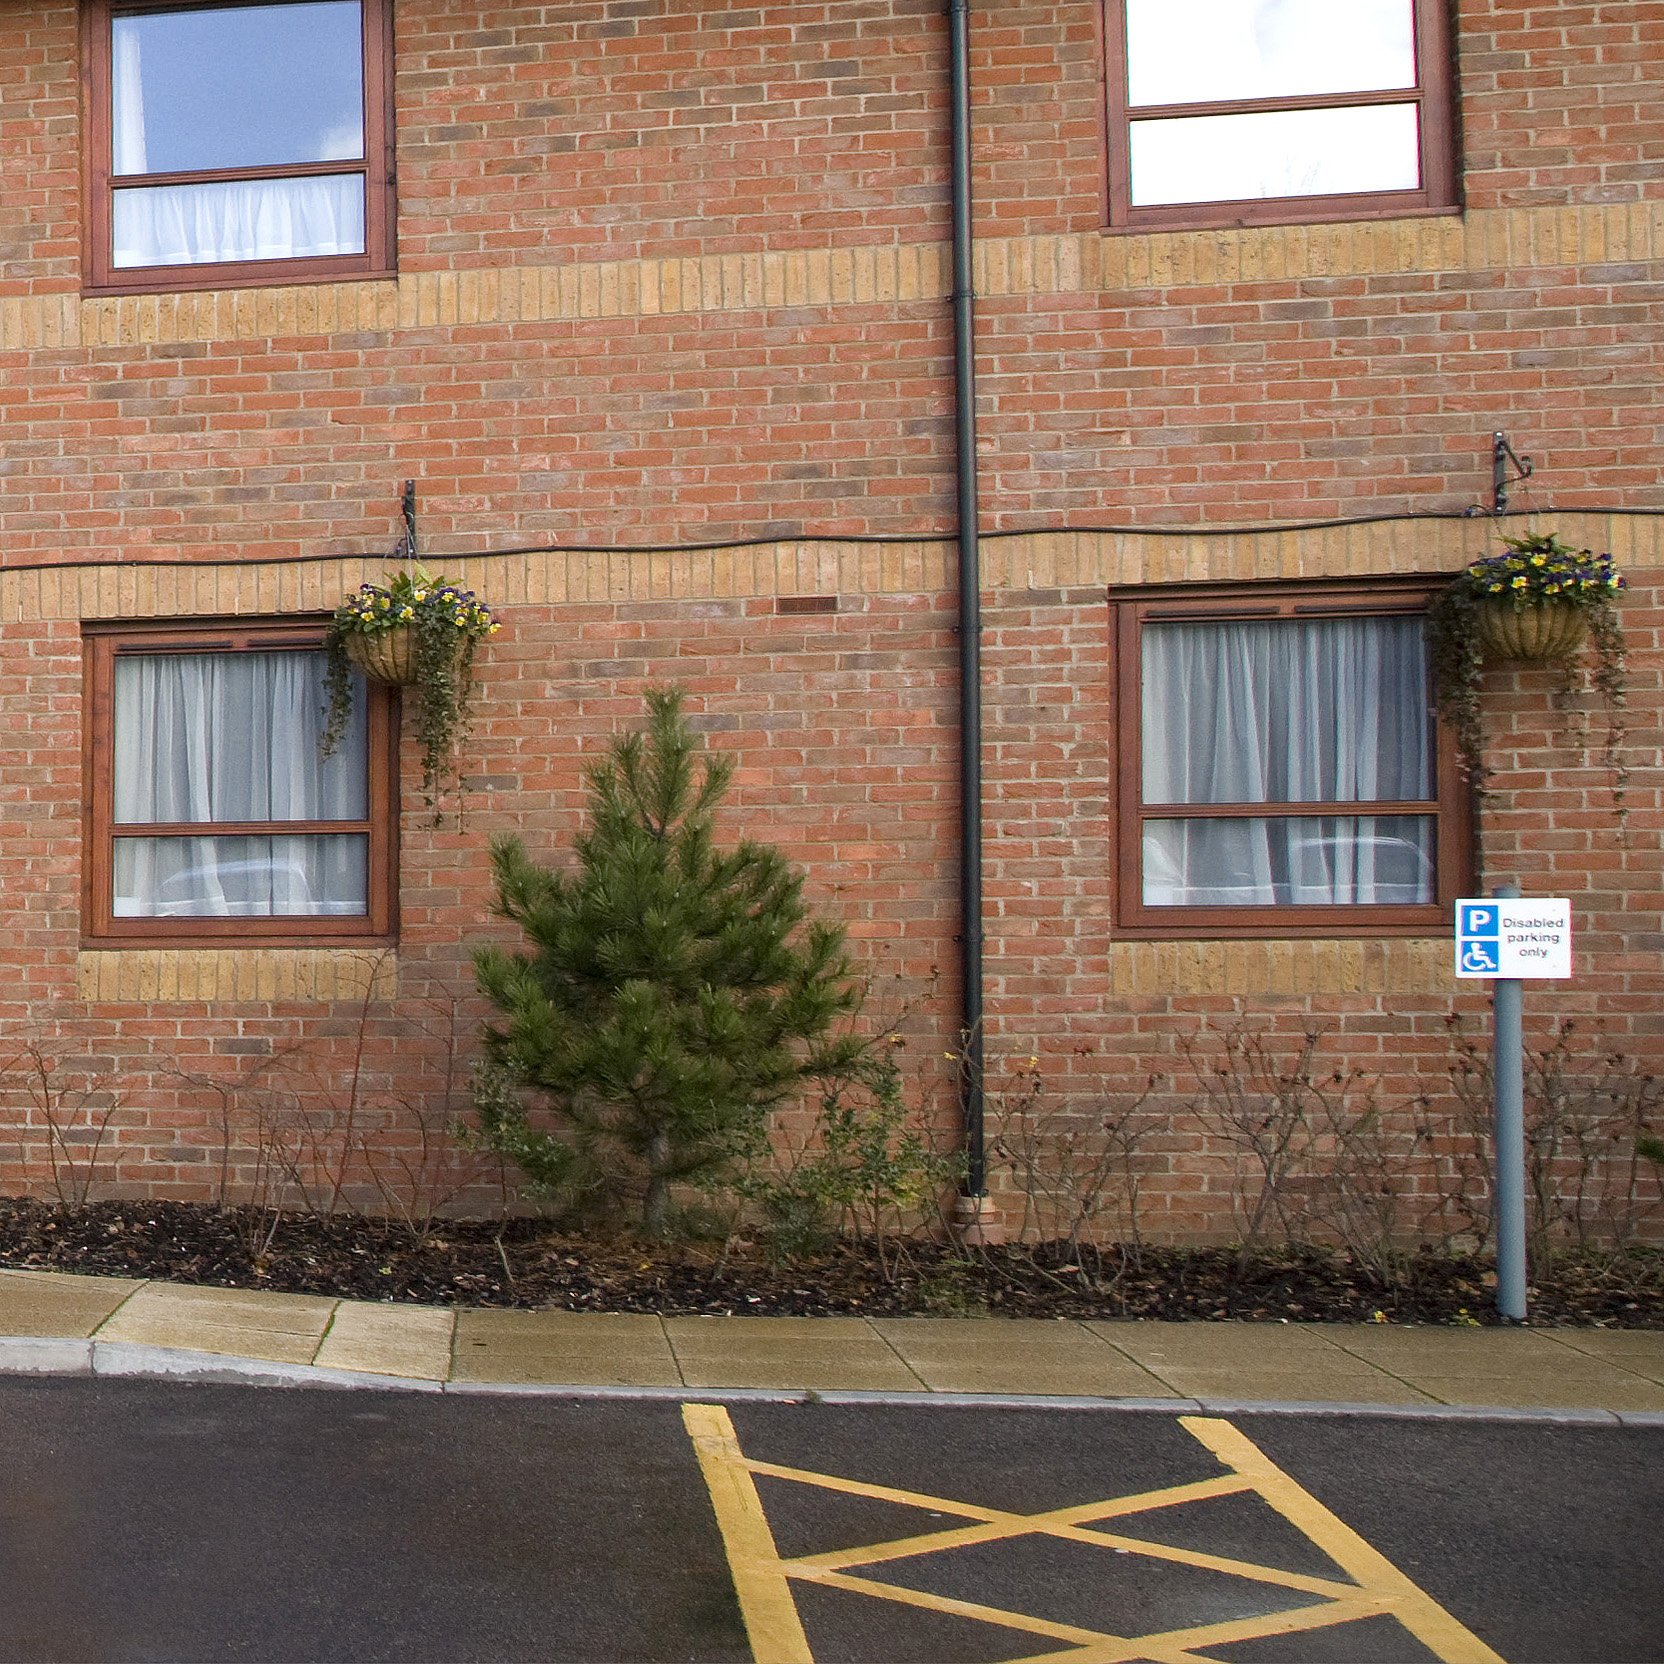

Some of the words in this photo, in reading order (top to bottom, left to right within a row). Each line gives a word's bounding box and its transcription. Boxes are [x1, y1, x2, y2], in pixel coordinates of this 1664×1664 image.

[1469, 909, 1492, 932] P
[1503, 918, 1564, 928] Disabled
[1507, 932, 1560, 944] parking
[1519, 947, 1548, 958] only
